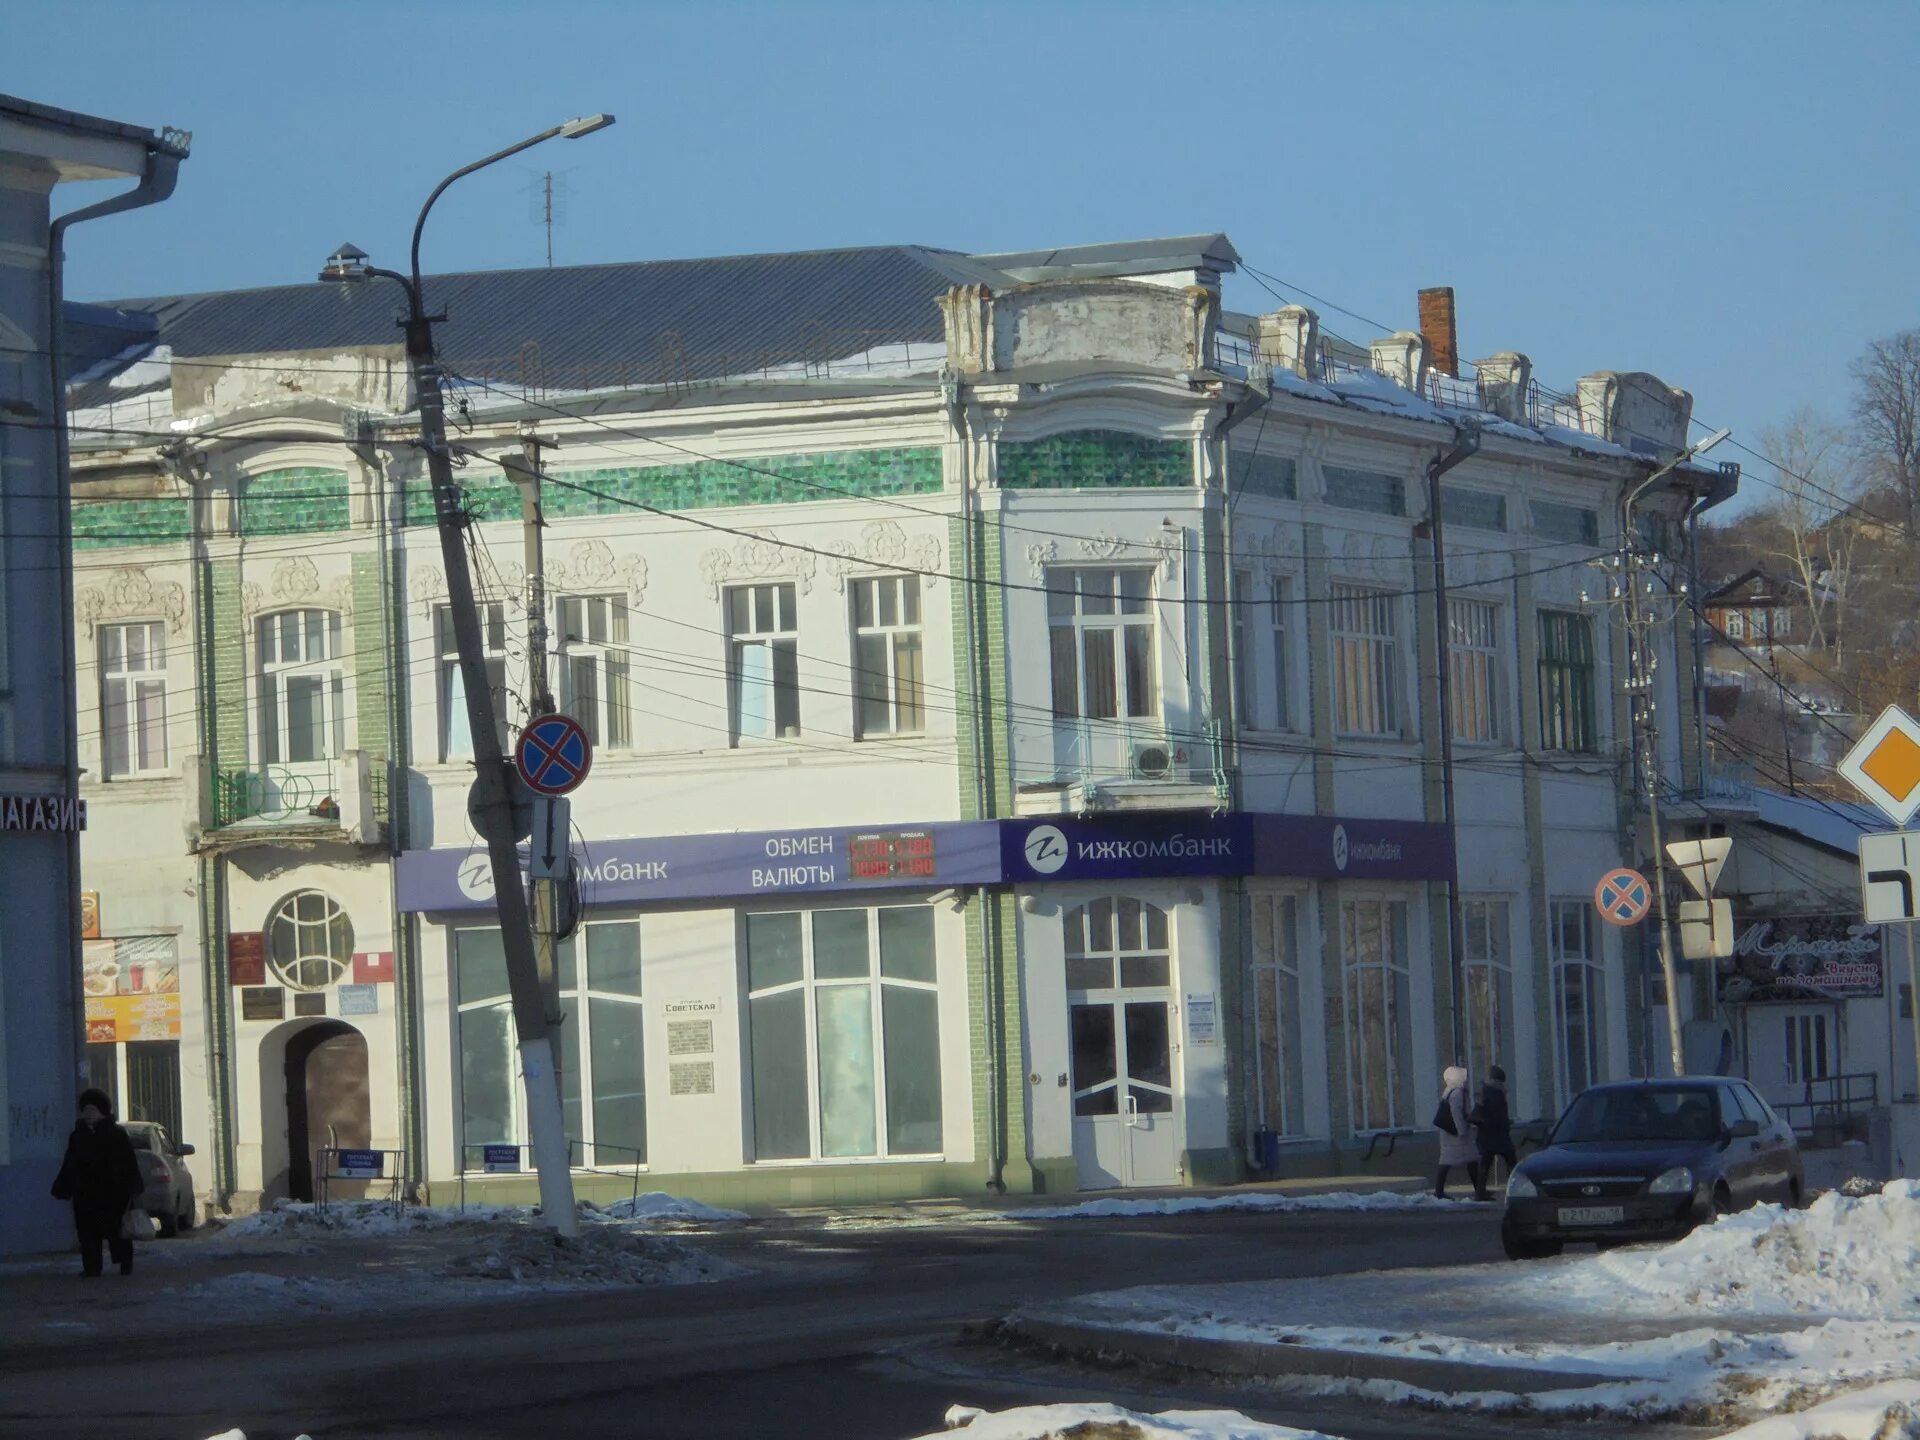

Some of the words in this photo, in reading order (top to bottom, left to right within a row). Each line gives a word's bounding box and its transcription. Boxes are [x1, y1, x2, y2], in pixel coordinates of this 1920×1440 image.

[0, 796, 87, 831] АГАЗИН
[765, 836, 833, 857] ОБМЕН
[1077, 833, 1232, 860] ижкомбанк
[752, 866, 835, 888] ВАЛЮТЫ
